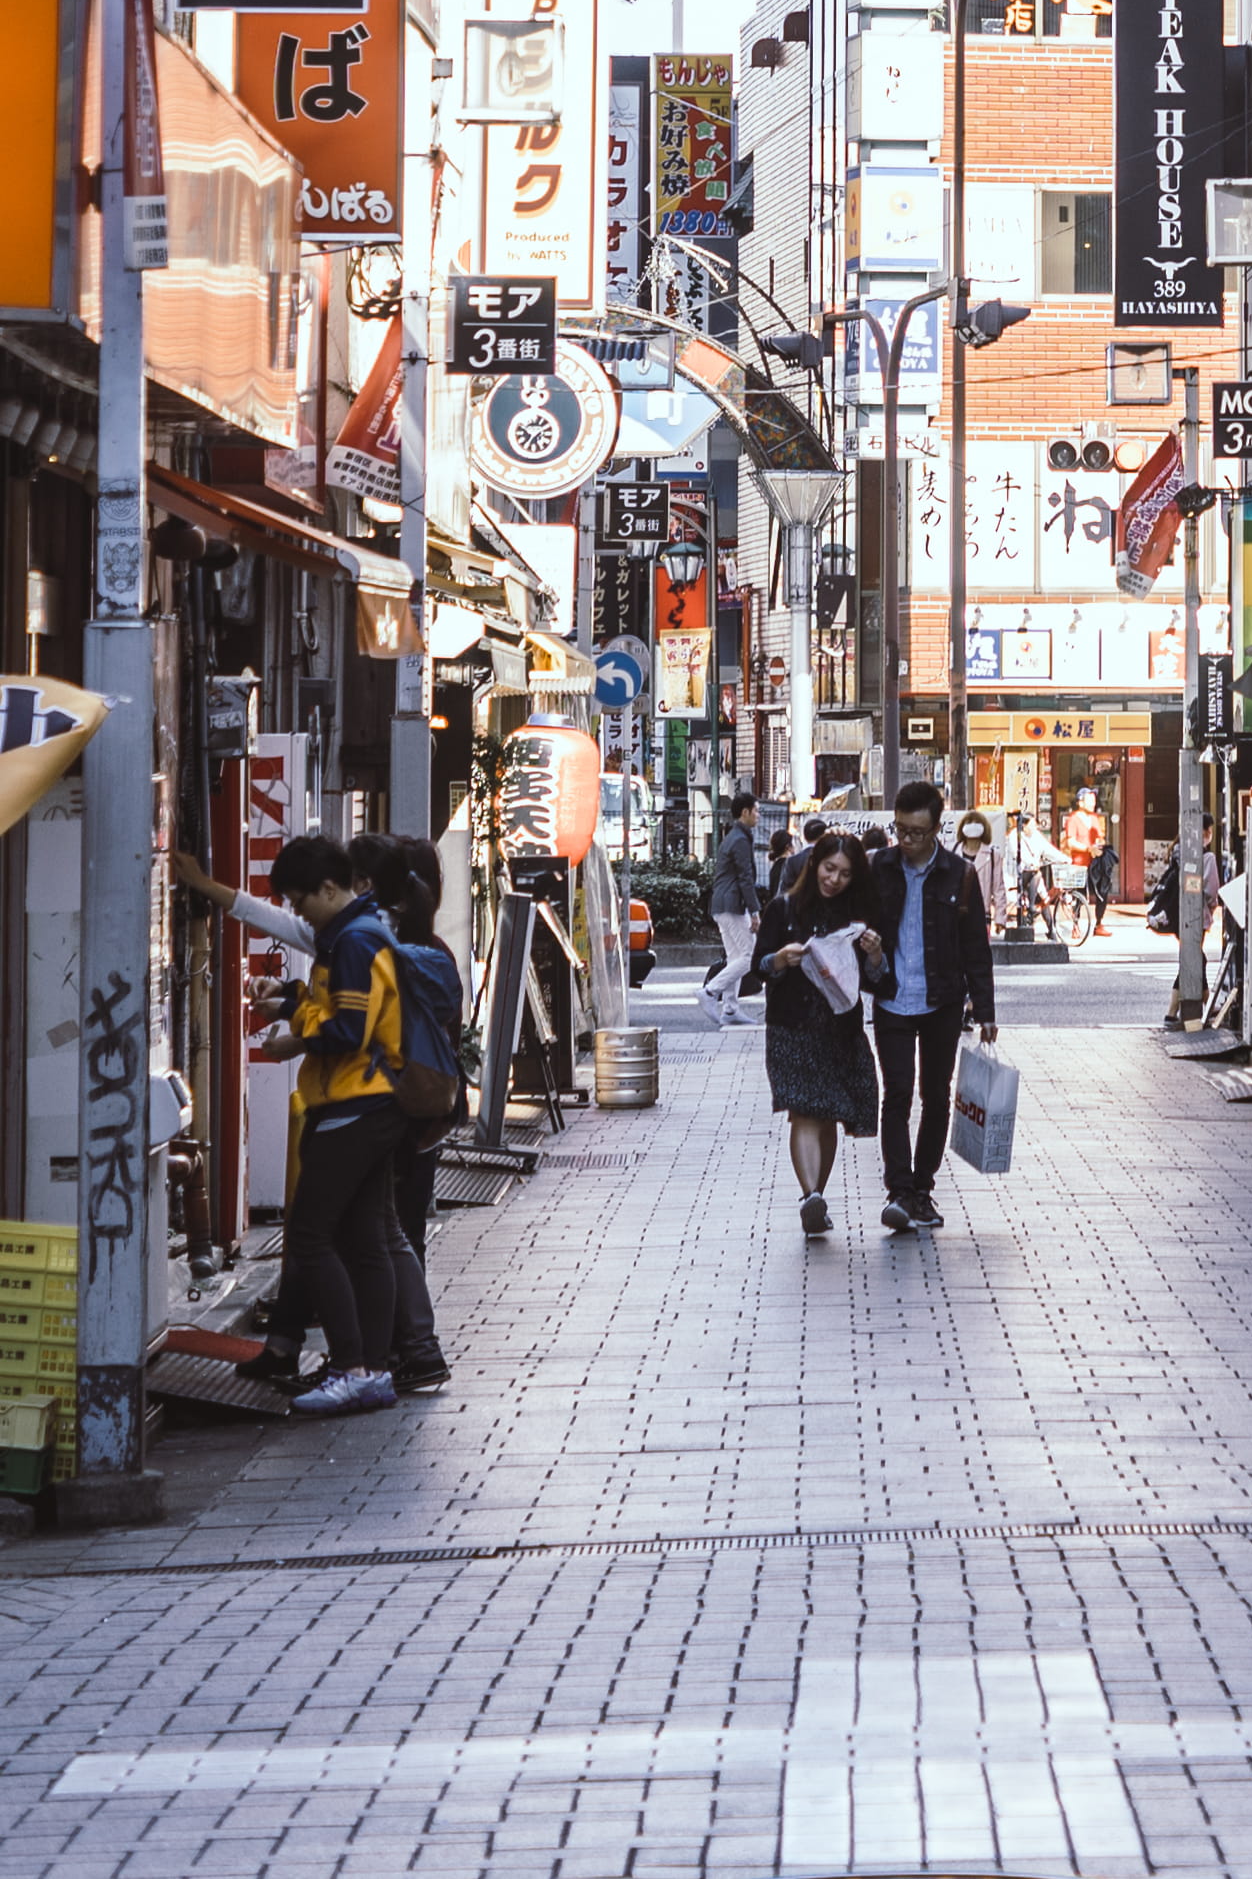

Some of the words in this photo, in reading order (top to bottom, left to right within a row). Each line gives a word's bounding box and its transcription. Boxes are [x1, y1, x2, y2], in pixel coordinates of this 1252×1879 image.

[658, 57, 729, 87] もんじゃ
[661, 101, 690, 197] お好み焼
[694, 121, 728, 200] 食べ放題
[1153, 109, 1186, 249] HOUSE
[506, 232, 570, 242] Produced
[659, 210, 730, 236] 1380円
[530, 251, 567, 260] WATTS
[468, 284, 541, 319] モア
[1153, 280, 1186, 299] 389
[1121, 301, 1218, 315] HAYASHIYA
[469, 328, 540, 369] 3番街
[618, 489, 661, 508] モア
[618, 513, 660, 537] 3番街
[916, 471, 947, 560] 麦めし
[992, 470, 1021, 560] 牛たん
[1053, 719, 1095, 739] 松屋
